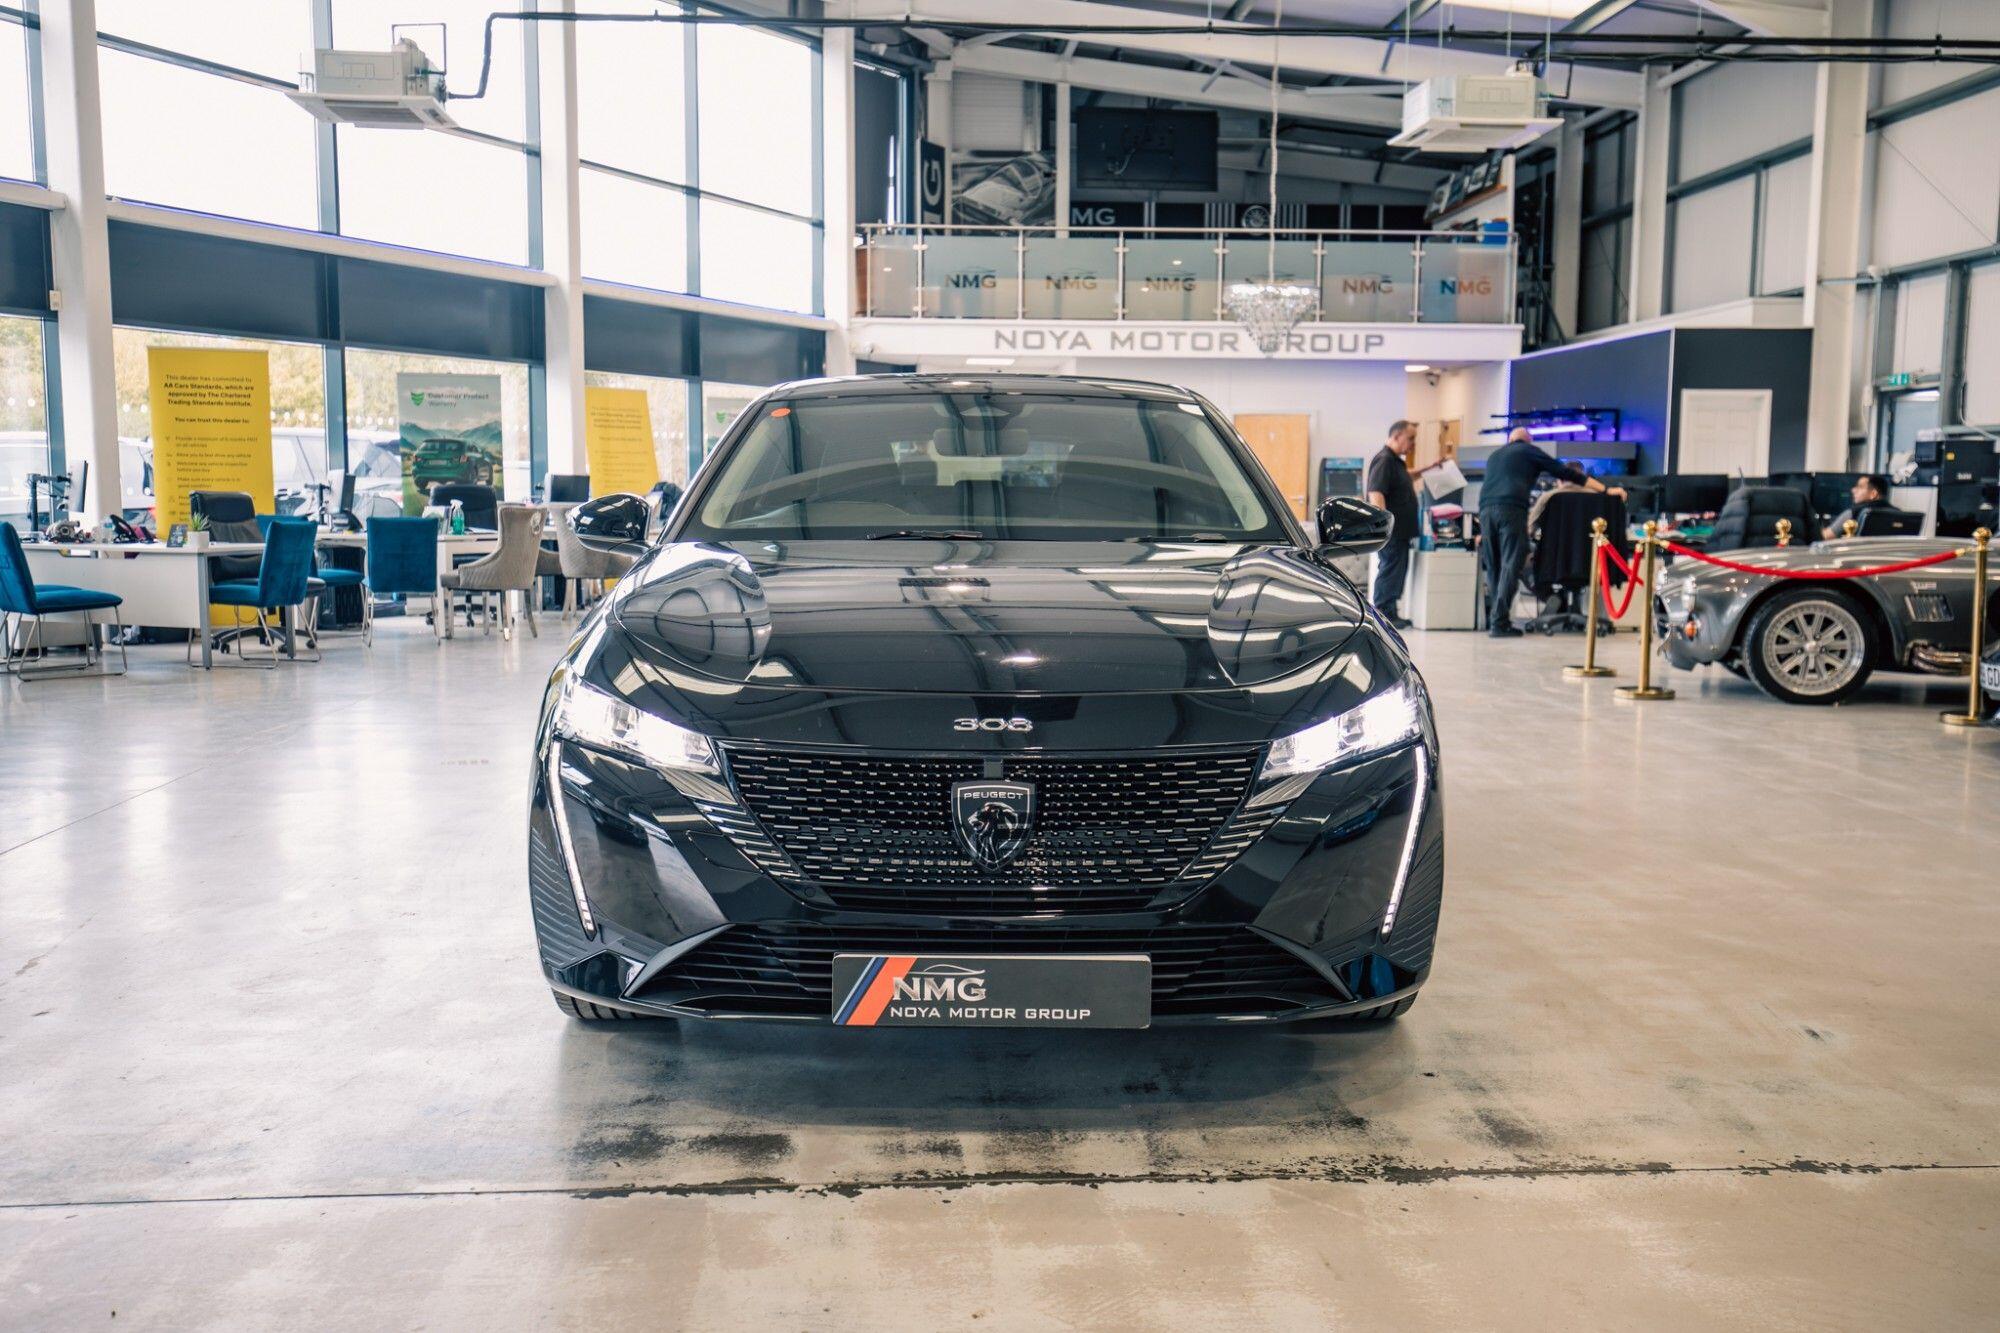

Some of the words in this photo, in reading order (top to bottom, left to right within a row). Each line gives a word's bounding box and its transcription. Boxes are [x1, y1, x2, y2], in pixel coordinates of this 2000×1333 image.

[1071, 207, 1116, 225] MG
[944, 273, 997, 289] NMG
[1045, 275, 1098, 290] NMG
[1145, 276, 1197, 291] NMG
[1342, 279, 1394, 294] NMG
[1439, 279, 1492, 294] NMG
[994, 329, 1092, 351] NOYA
[1110, 330, 1241, 352] MOTOR
[953, 717, 1034, 732] 308
[963, 791, 1024, 800] PEUGEOT
[892, 976, 987, 1002] NMG
[890, 1006, 941, 1018] NOYA
[949, 1007, 1017, 1019] MOTOR
[1025, 1008, 1091, 1020] GROUP
